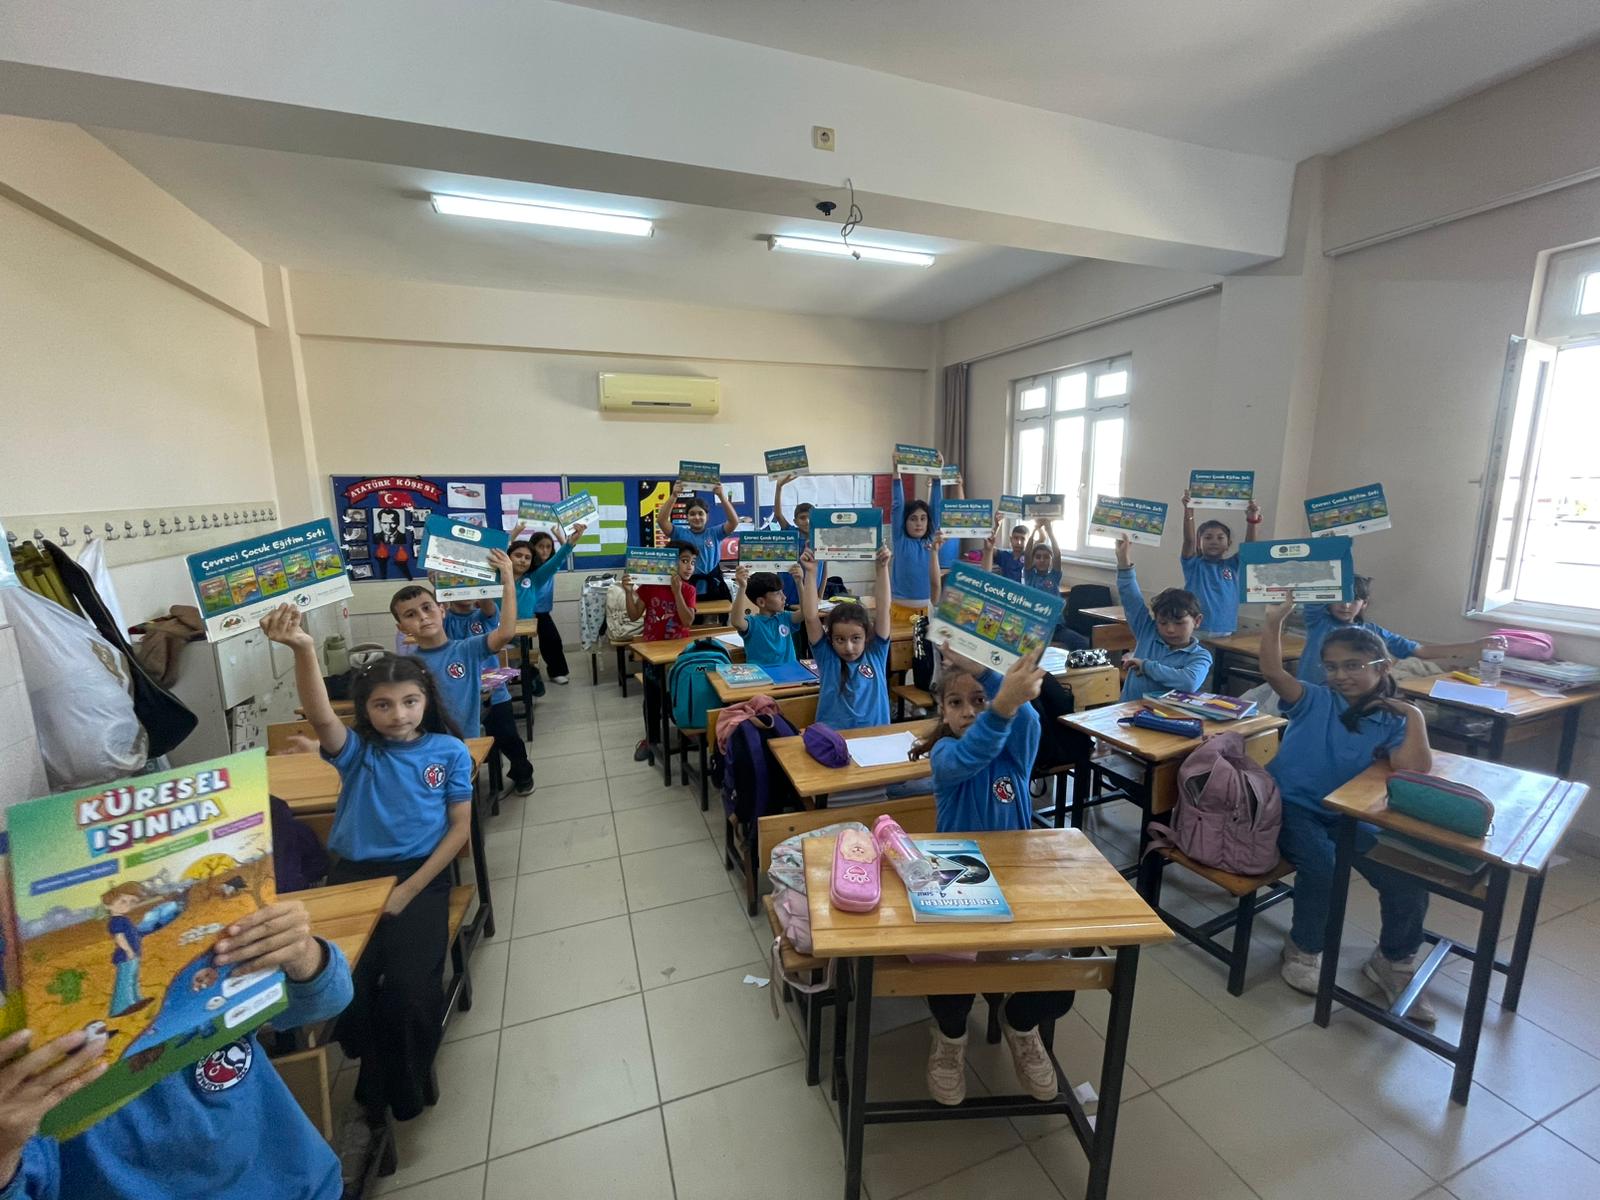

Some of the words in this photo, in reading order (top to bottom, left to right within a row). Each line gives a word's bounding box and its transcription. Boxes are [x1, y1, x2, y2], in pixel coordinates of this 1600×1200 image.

[350, 479, 391, 497] ATATÜRK
[201, 552, 239, 570] Çevreci
[241, 543, 270, 558] Çocuk
[272, 536, 304, 550] Eğitim
[306, 528, 326, 540] Seti
[955, 571, 983, 588] Çevreci
[984, 582, 1007, 598] Çocuk
[1006, 592, 1033, 609] Eğitim
[1033, 602, 1053, 617] Seti
[79, 770, 227, 824] KÜRESEL
[94, 799, 220, 849] ISINMA
